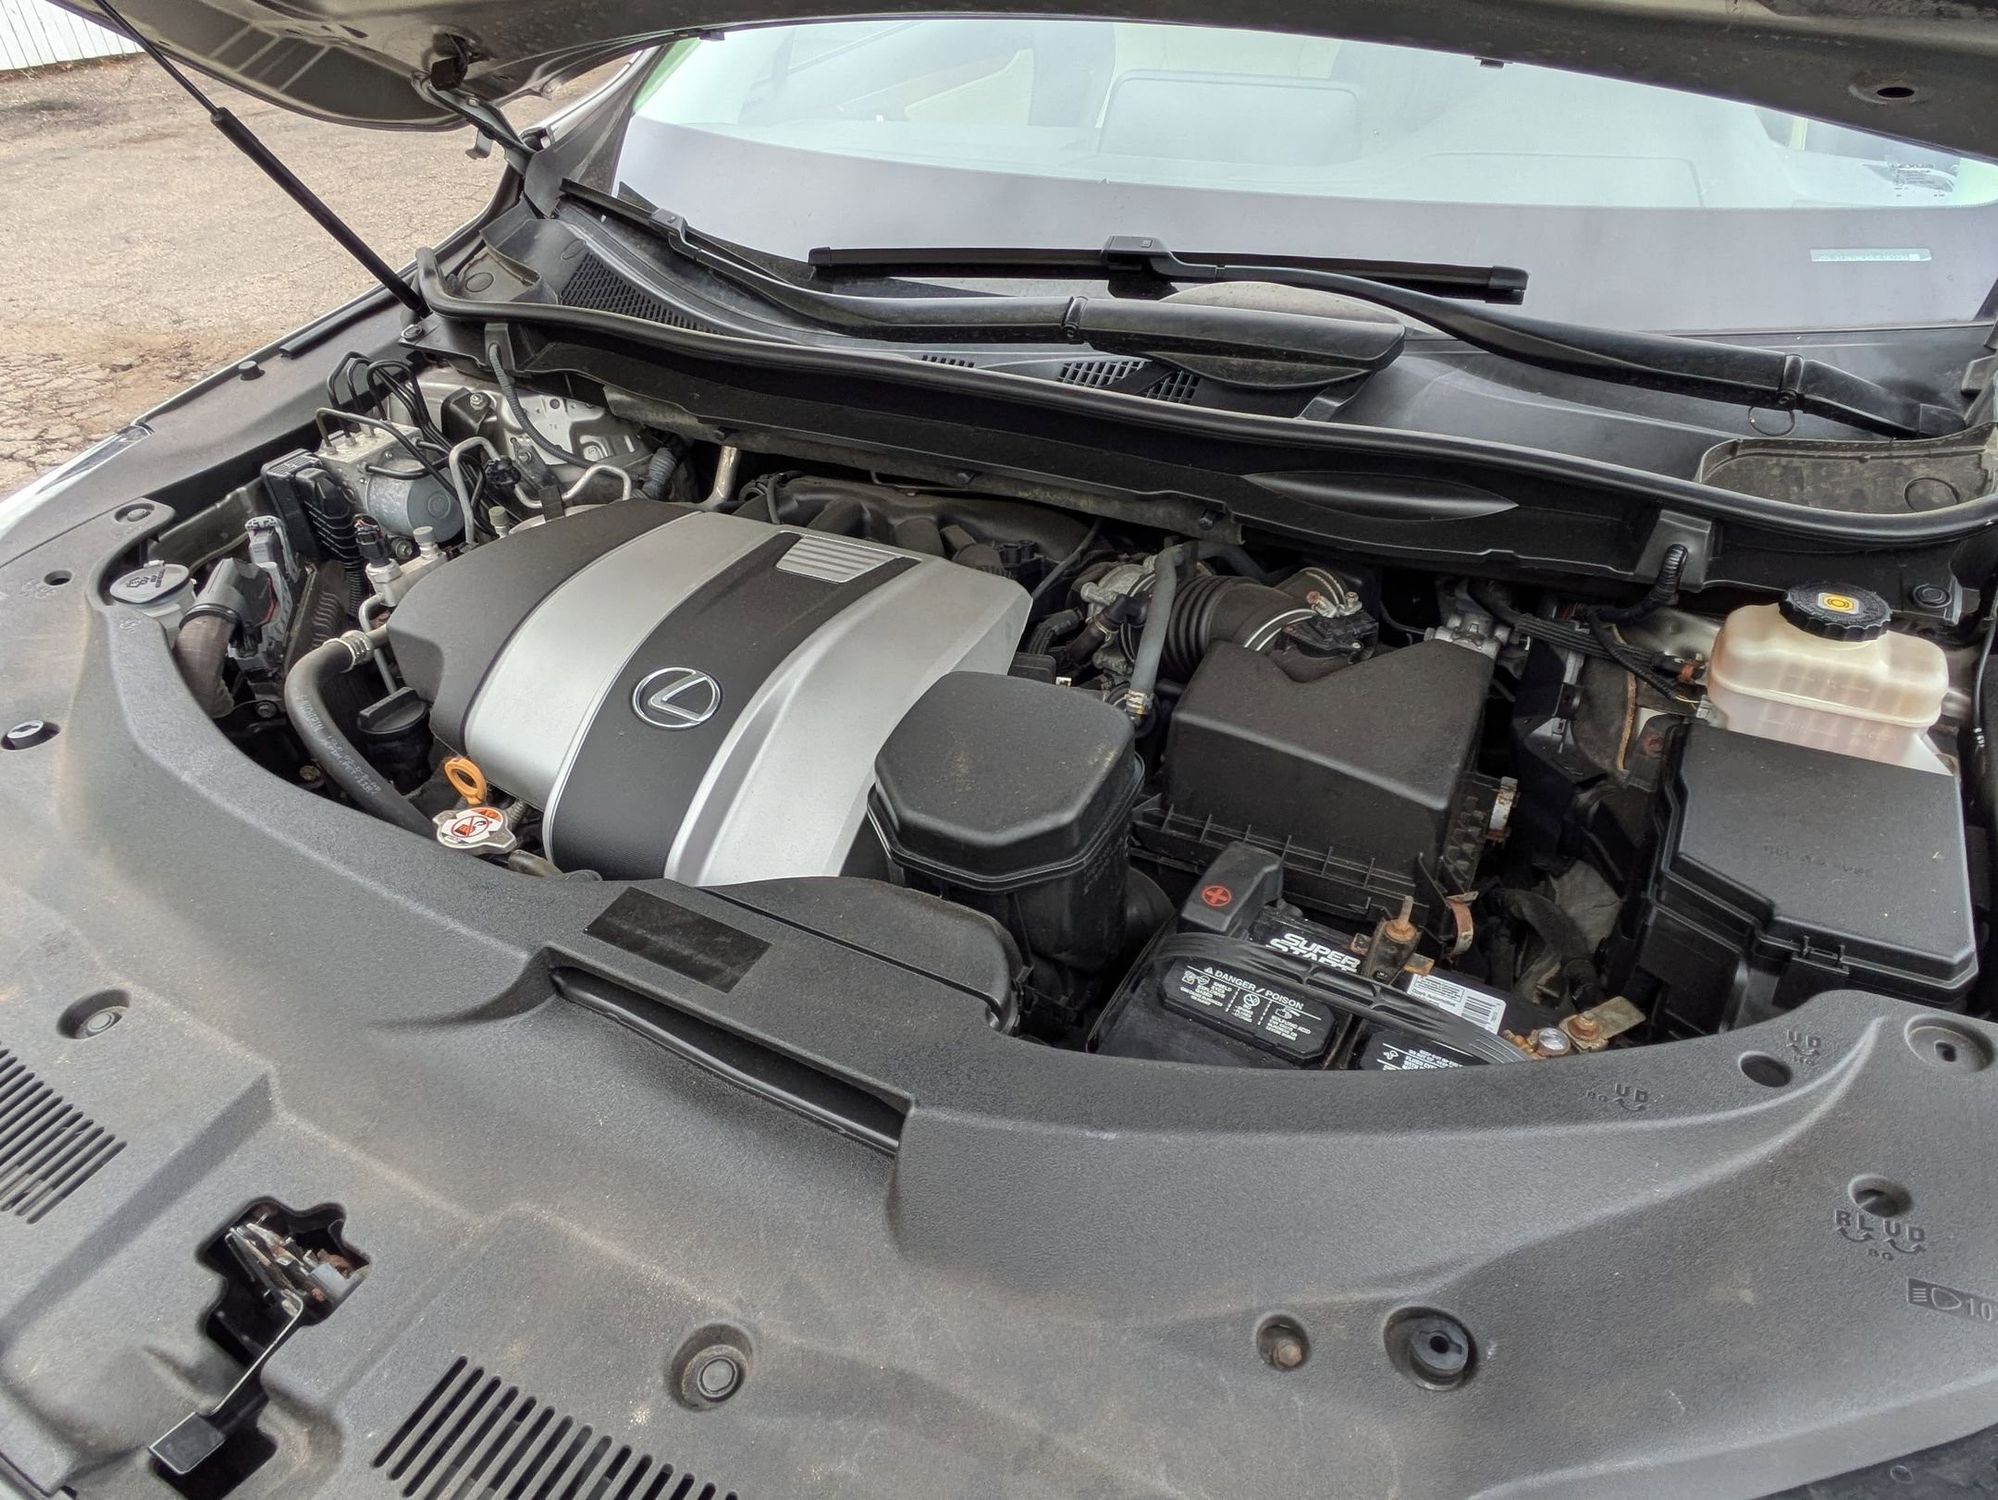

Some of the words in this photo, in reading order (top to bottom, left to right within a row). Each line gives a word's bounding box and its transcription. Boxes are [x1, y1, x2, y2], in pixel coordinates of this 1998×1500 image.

[1284, 932, 1361, 969] SUPER
[1214, 969, 1257, 991] DANGER
[1265, 989, 1305, 1010] POISON
